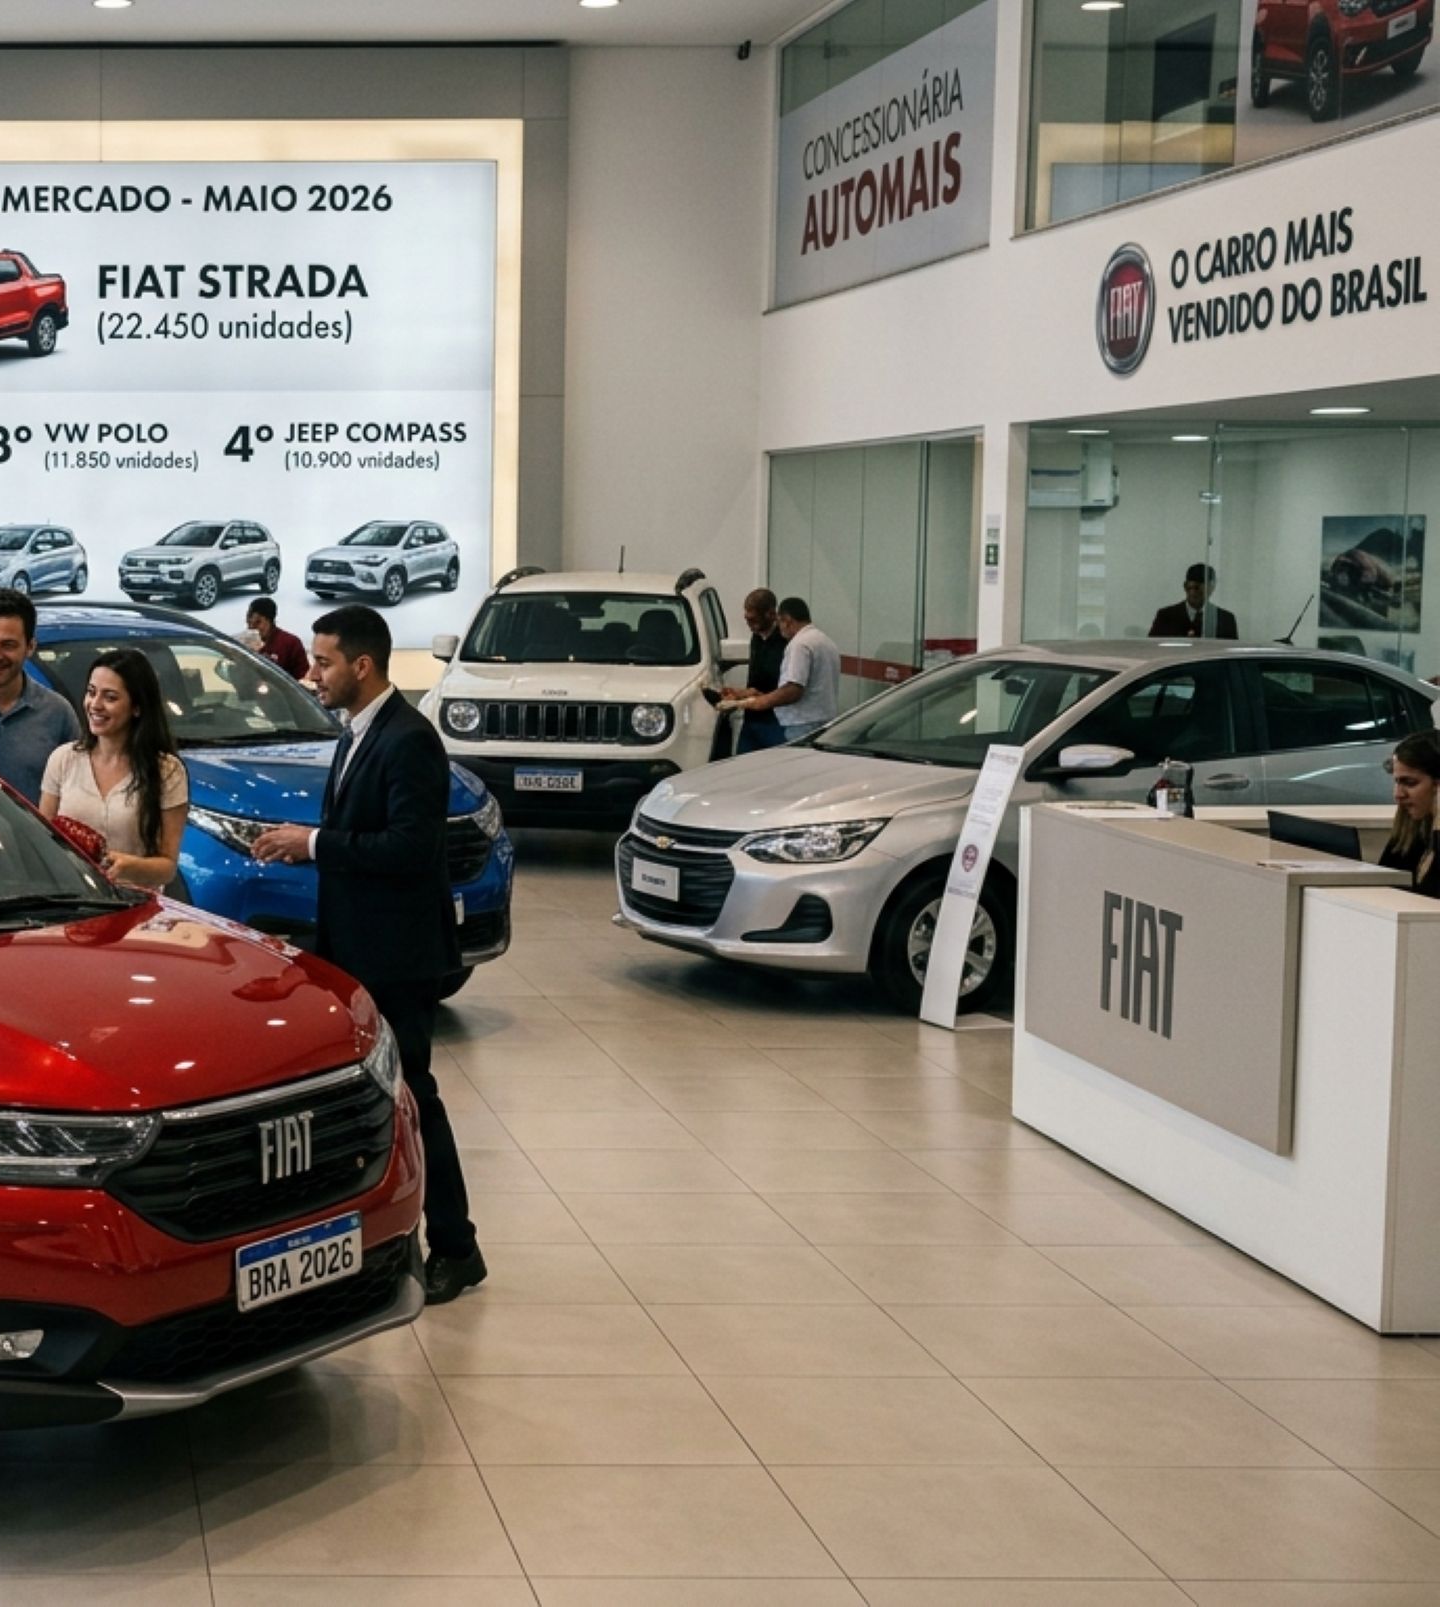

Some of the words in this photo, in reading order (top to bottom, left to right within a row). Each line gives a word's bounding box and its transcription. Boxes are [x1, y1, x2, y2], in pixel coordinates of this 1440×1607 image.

[803, 67, 963, 181] CONCESSIONÁRIA
[1, 185, 171, 213] MERCADO
[203, 184, 298, 212] MAIO
[307, 184, 393, 212] 2026
[801, 131, 962, 256] AUTOMAIS
[1170, 248, 1189, 290] O
[1195, 226, 1277, 285] CARRO
[1283, 206, 1354, 266] MAIS
[98, 264, 186, 299] FIAT
[198, 264, 369, 300] STRADA
[1109, 280, 1144, 342] FIAT
[1167, 286, 1275, 344] VENDIDO
[1281, 277, 1323, 325] DO
[1329, 255, 1428, 318] BRASIL
[97, 311, 209, 345] (22.450
[218, 310, 352, 344] unidades)
[44, 423, 90, 444] VW
[97, 423, 168, 444] POLO
[44, 450, 111, 472] (11.850
[284, 422, 339, 443] JEEP
[346, 422, 467, 443] COMPASS
[285, 450, 352, 471] (10.900
[1100, 890, 1183, 1040] FIAT
[258, 1110, 314, 1185] FIAT
[248, 1258, 291, 1301] BRA
[300, 1237, 354, 1285] 2026
